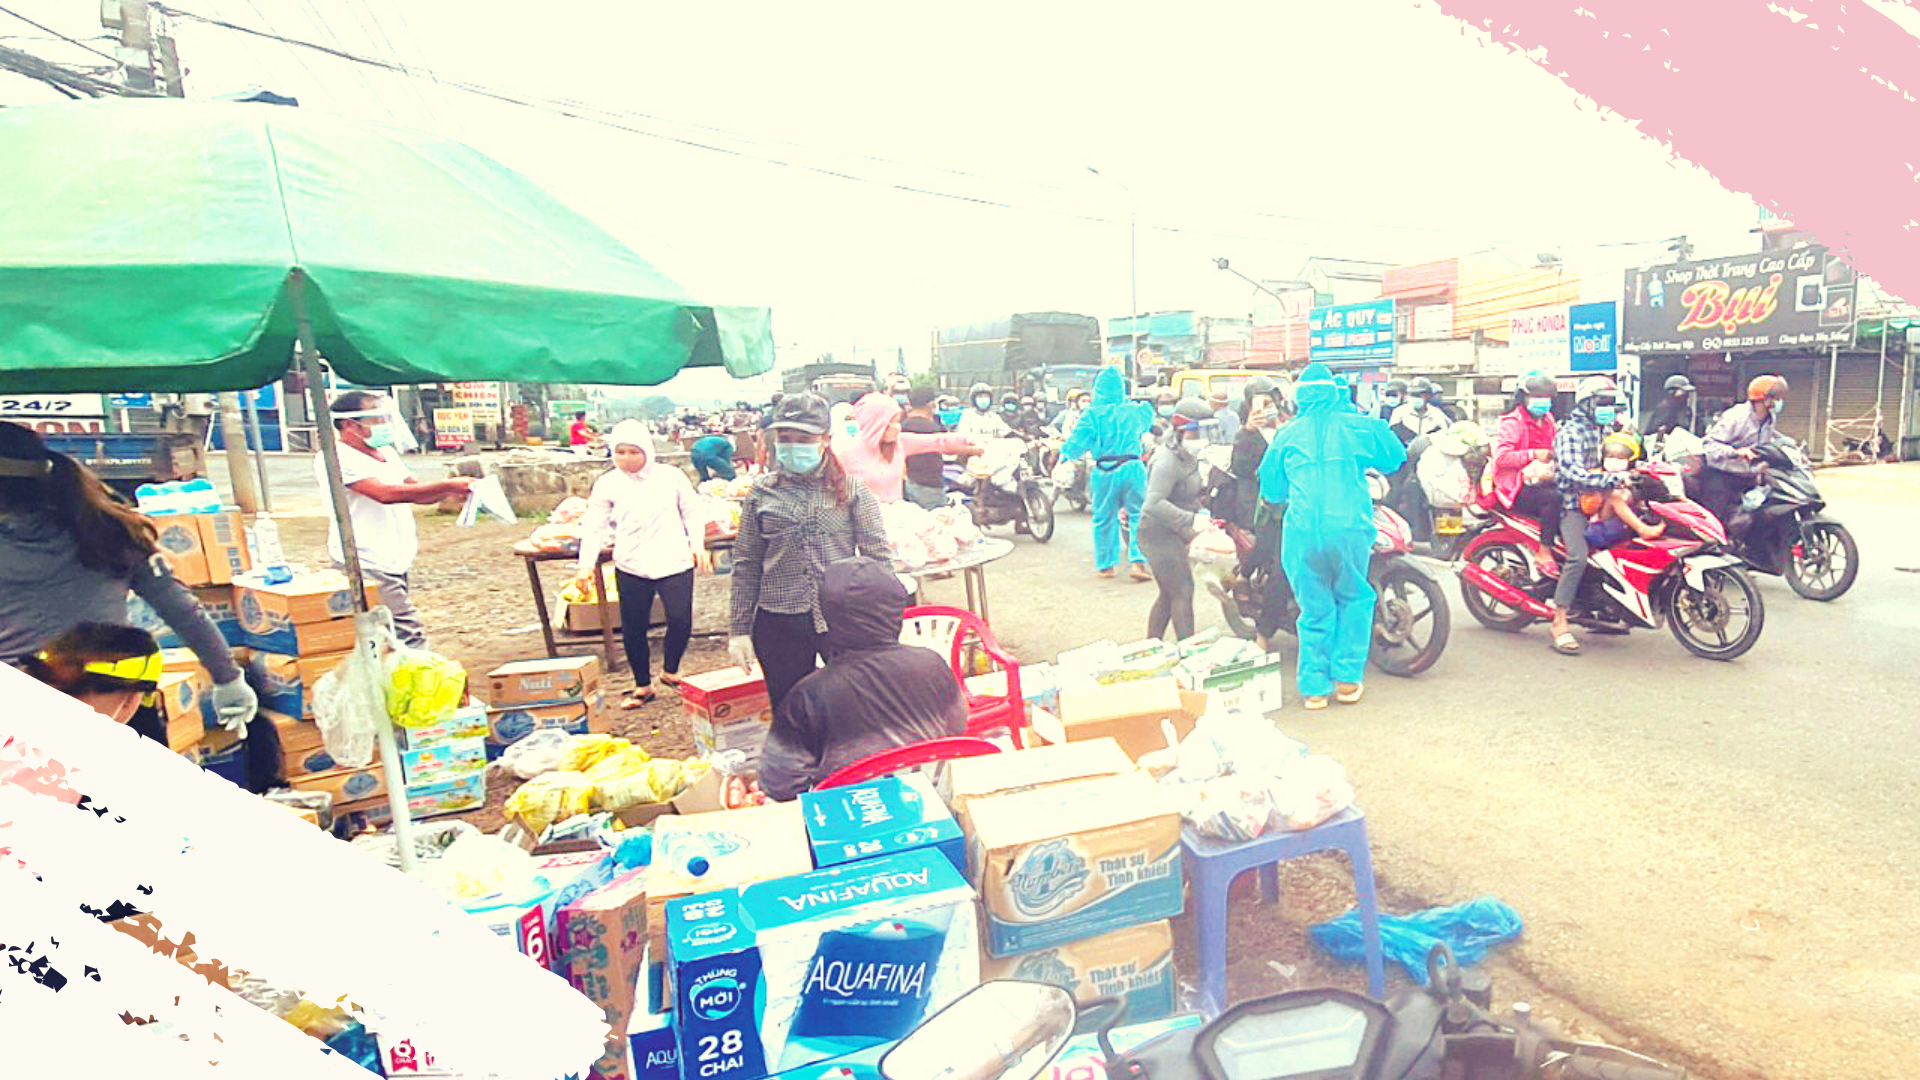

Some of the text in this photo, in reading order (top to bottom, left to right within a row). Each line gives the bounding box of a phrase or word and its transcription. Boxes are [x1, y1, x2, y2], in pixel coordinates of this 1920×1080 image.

[1665, 269, 1692, 285] Shop
[1722, 261, 1757, 278] Trang
[1759, 257, 1785, 273] Cao
[1788, 250, 1815, 271] Cấp
[1677, 273, 1784, 334] Bụi
[1346, 308, 1376, 328] QUY
[1537, 314, 1567, 332] HONDA
[1573, 334, 1612, 354] Mobil
[2, 400, 72, 411] 24/7
[1100, 857, 1127, 875] Thật
[777, 867, 928, 912] AQUAFINA
[1107, 872, 1134, 888] Tinh
[526, 926, 544, 961] 6
[804, 955, 926, 998] AQUAFINA
[699, 986, 733, 1009] MỚI
[698, 1029, 743, 1062] 28
[699, 1055, 744, 1077] CHAI
